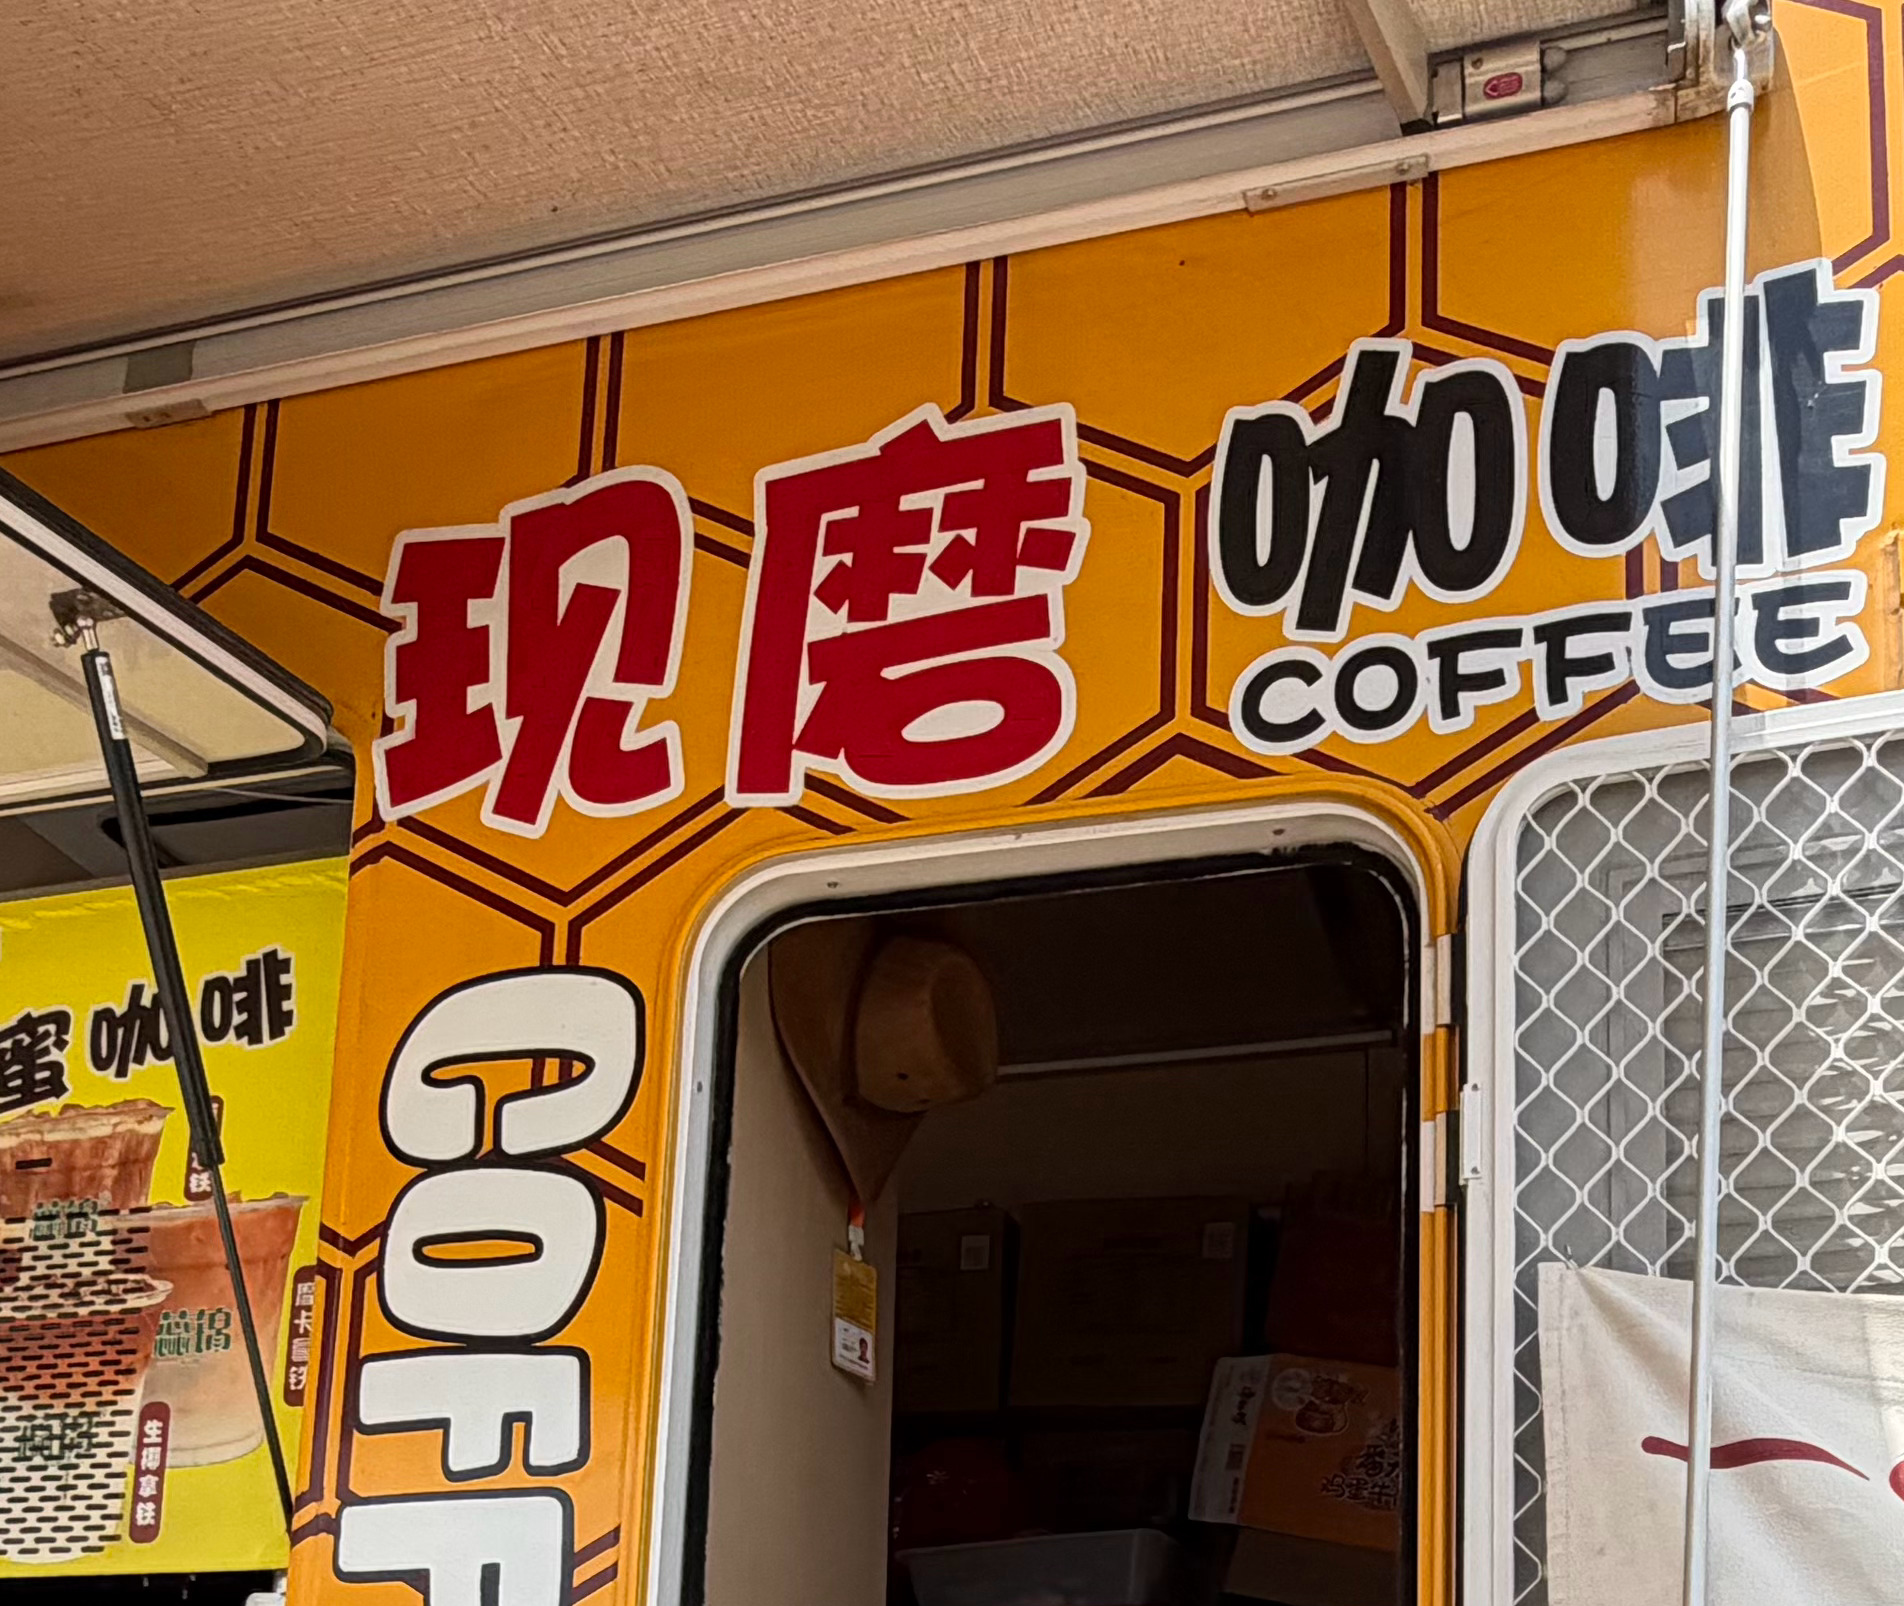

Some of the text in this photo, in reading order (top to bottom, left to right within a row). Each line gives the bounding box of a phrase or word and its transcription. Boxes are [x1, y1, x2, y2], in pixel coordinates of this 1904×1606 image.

[382, 416, 1080, 825] 现磨
[1219, 267, 1873, 635] 咖啡
[1242, 576, 1862, 746] COFFEE
